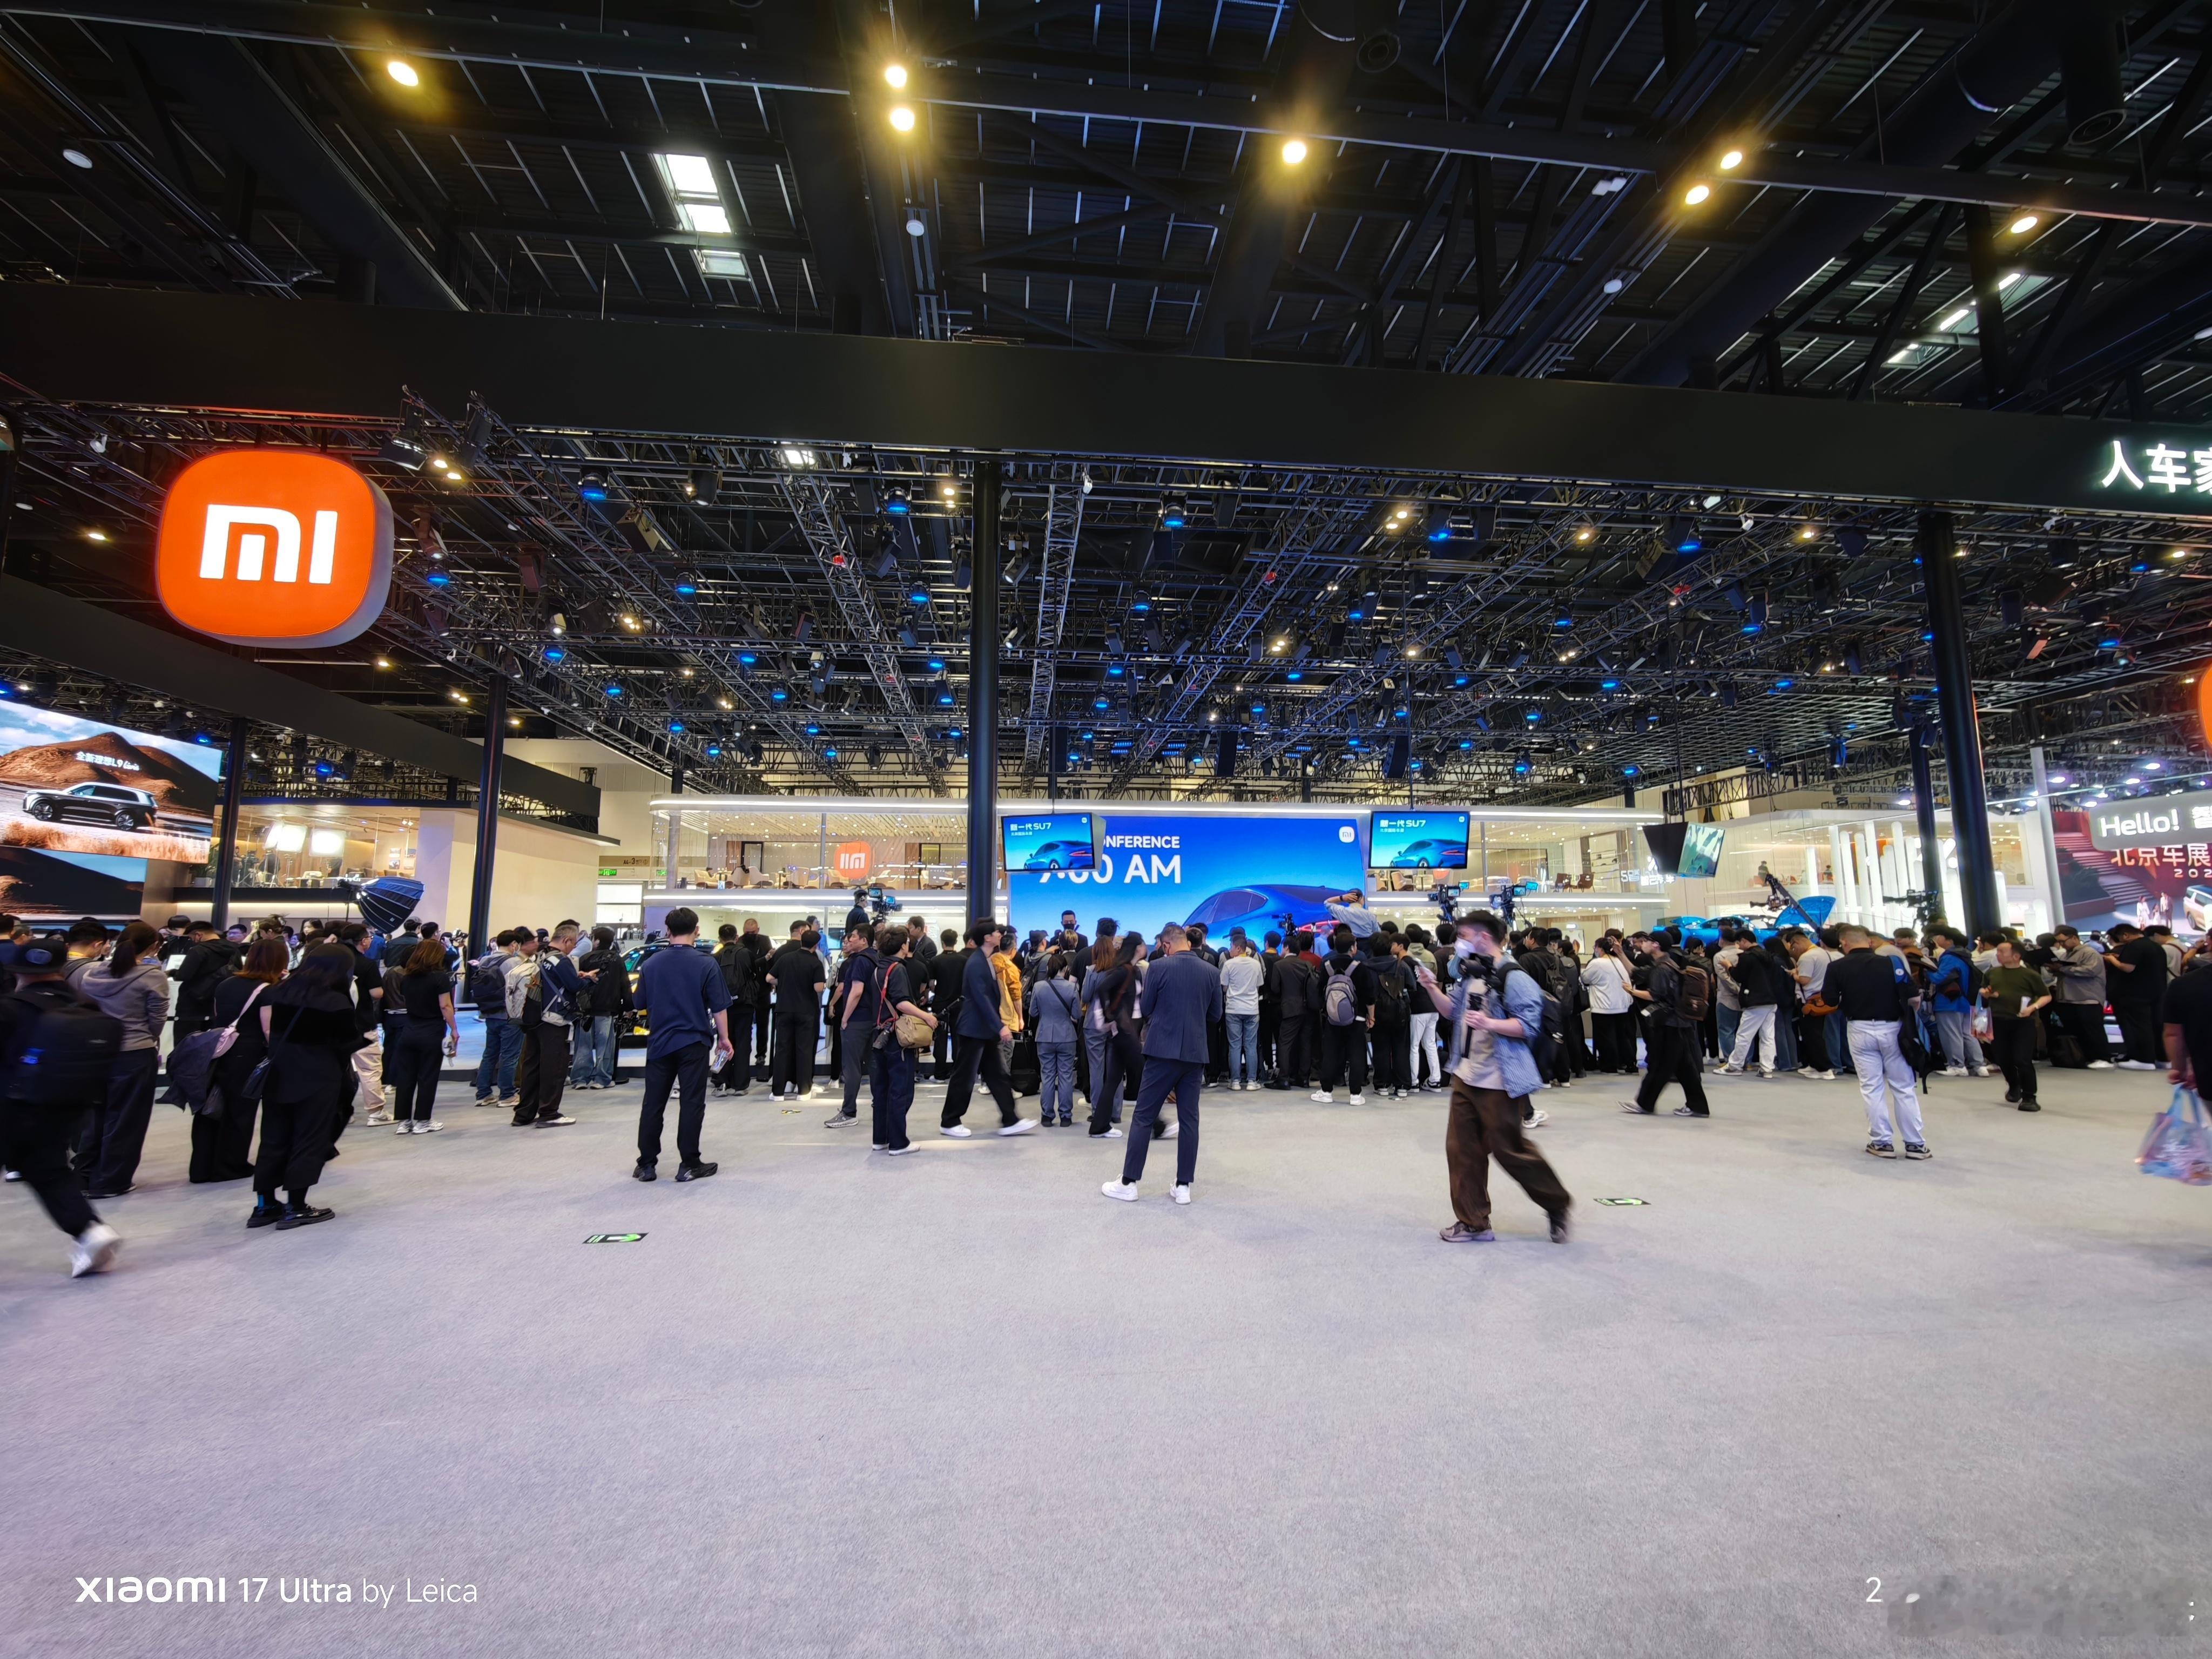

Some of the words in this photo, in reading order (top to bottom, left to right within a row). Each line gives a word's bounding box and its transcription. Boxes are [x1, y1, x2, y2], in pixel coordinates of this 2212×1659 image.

[2100, 809, 2180, 837] Hello!
[1103, 835, 1180, 848] NFERENCE
[1124, 854, 1181, 884] AM
